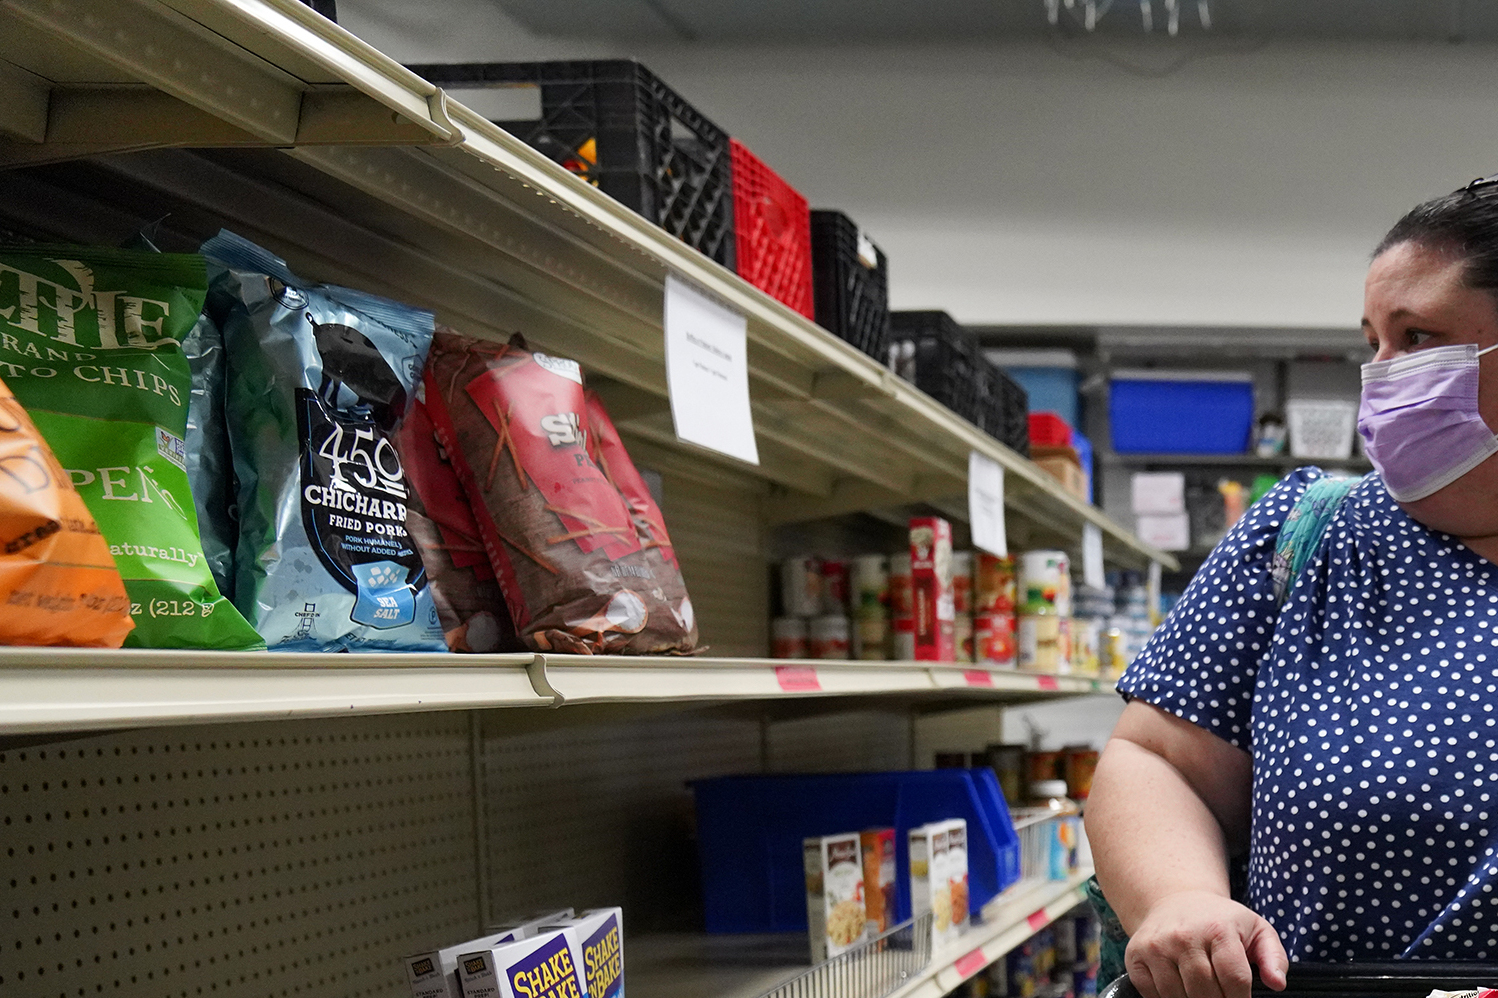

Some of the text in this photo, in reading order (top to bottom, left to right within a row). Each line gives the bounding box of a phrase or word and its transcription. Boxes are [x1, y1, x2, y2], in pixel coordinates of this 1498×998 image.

[0, 332, 97, 362] RAND
[73, 366, 182, 407] CHIPS
[329, 514, 361, 532] FRIED
[341, 542, 396, 557] WITHOUT ADDED
[345, 535, 362, 545] PORK
[109, 542, 202, 567] aturally
[149, 598, 195, 618] (212
[377, 597, 398, 609] SEA
[374, 608, 400, 620] SALT
[585, 926, 619, 978] SHAKE
